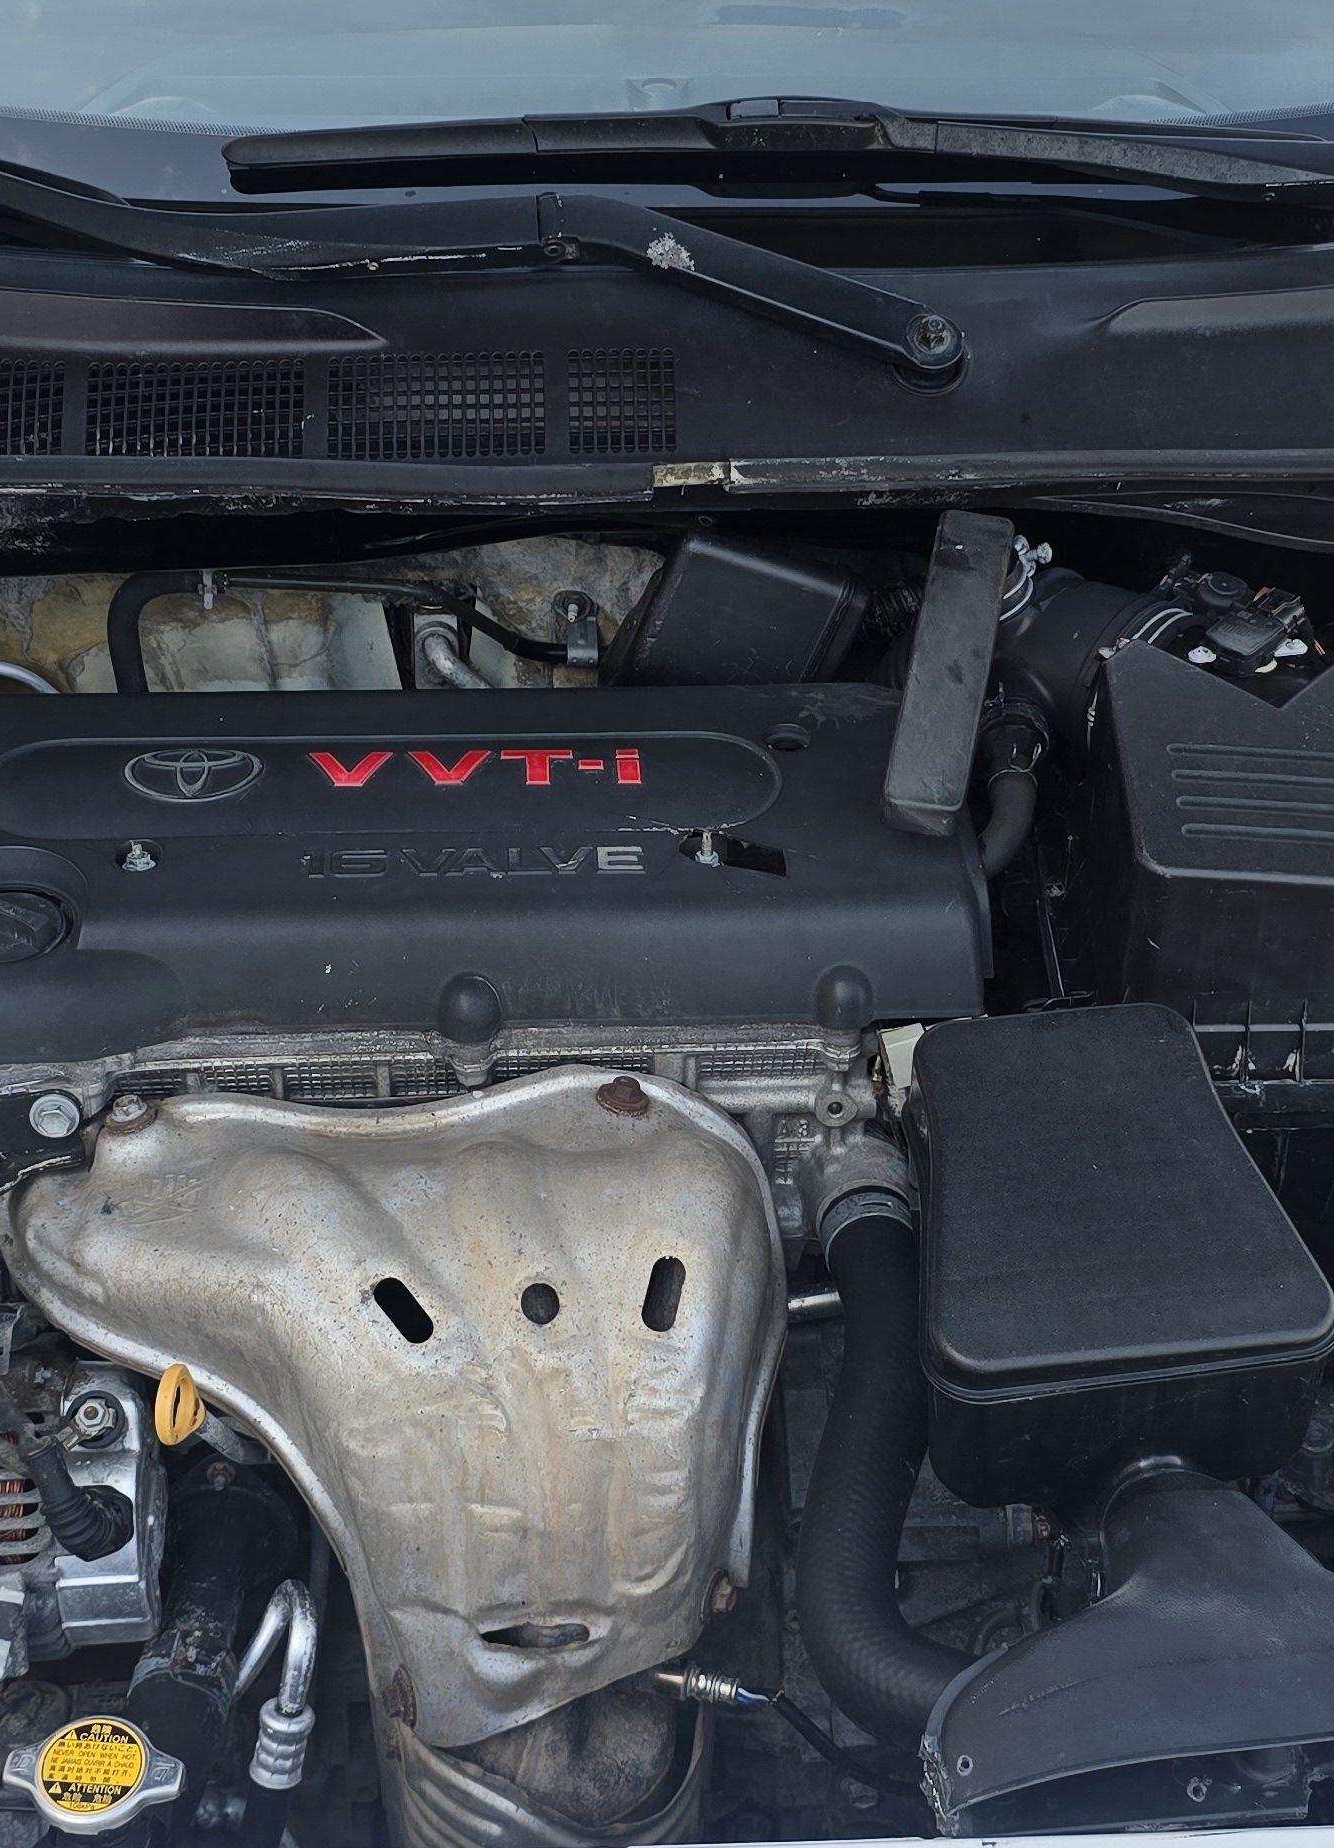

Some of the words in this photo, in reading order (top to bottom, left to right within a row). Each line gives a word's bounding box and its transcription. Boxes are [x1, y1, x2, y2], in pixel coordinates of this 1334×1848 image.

[308, 749, 642, 787] VVT-i
[301, 849, 388, 878] 16
[401, 846, 647, 878] VALVE
[79, 1732, 129, 1744] CAUTION
[78, 1750, 95, 1758] OPEN
[68, 1783, 122, 1795] ATTENTION
